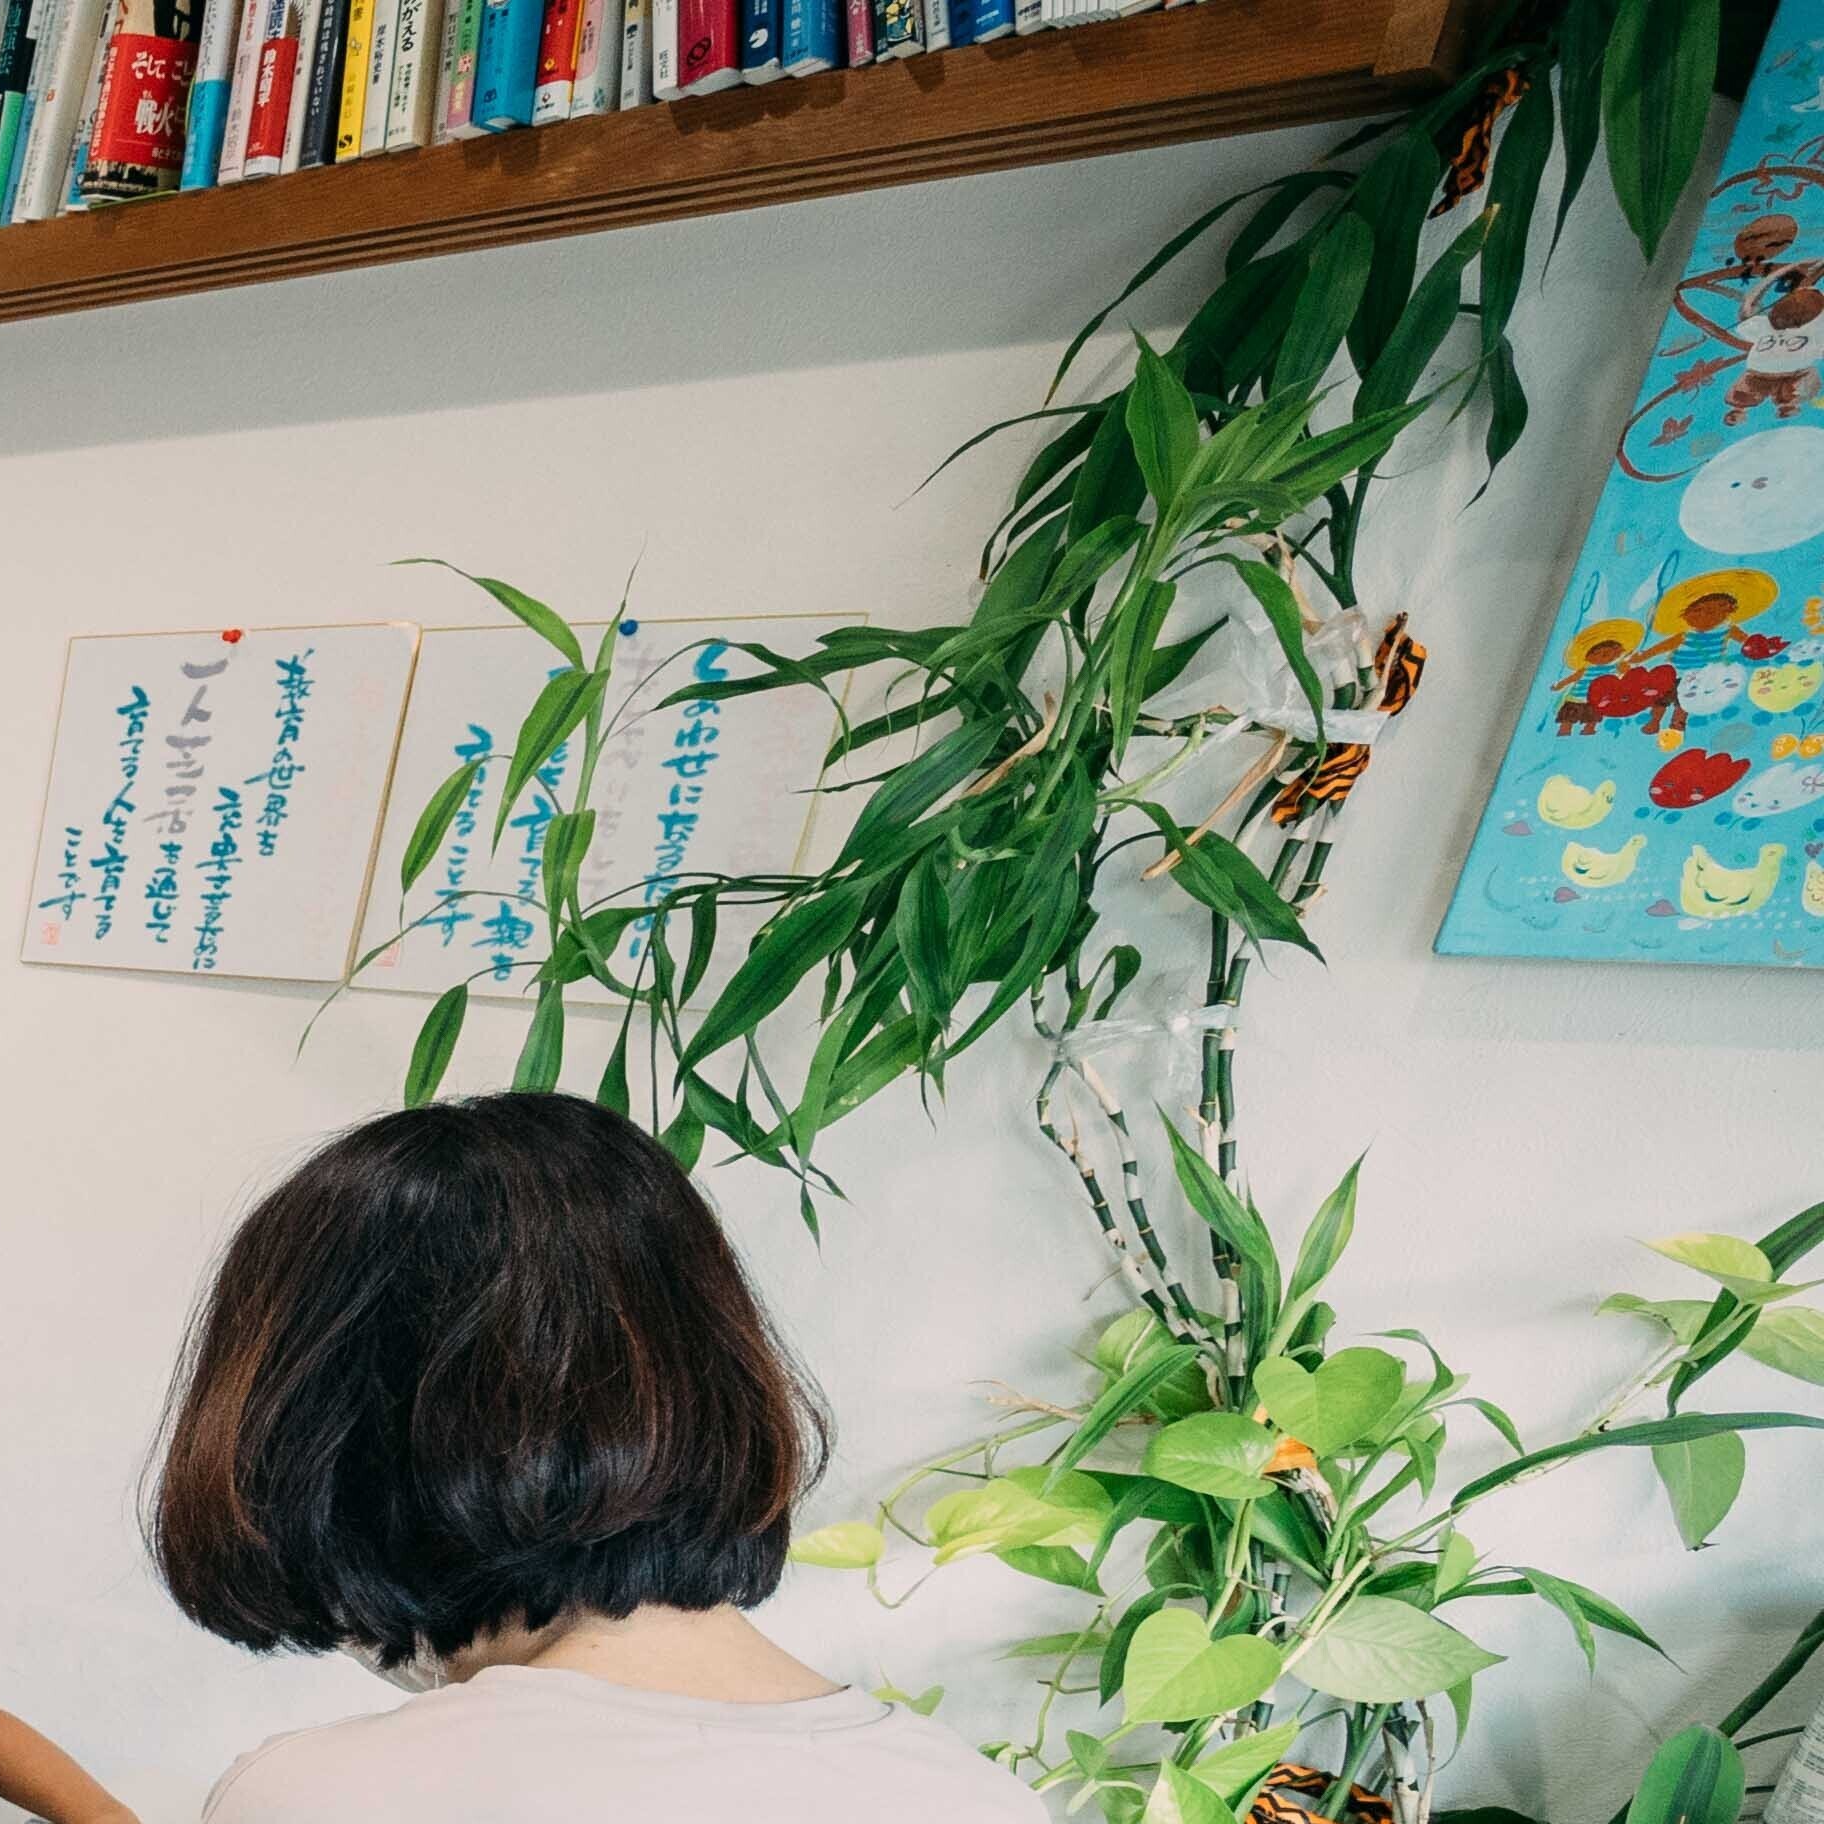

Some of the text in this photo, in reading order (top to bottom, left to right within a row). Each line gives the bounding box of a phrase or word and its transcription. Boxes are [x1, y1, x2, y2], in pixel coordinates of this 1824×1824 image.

[131, 50, 166, 80] そして
[38, 826, 88, 921] ことです
